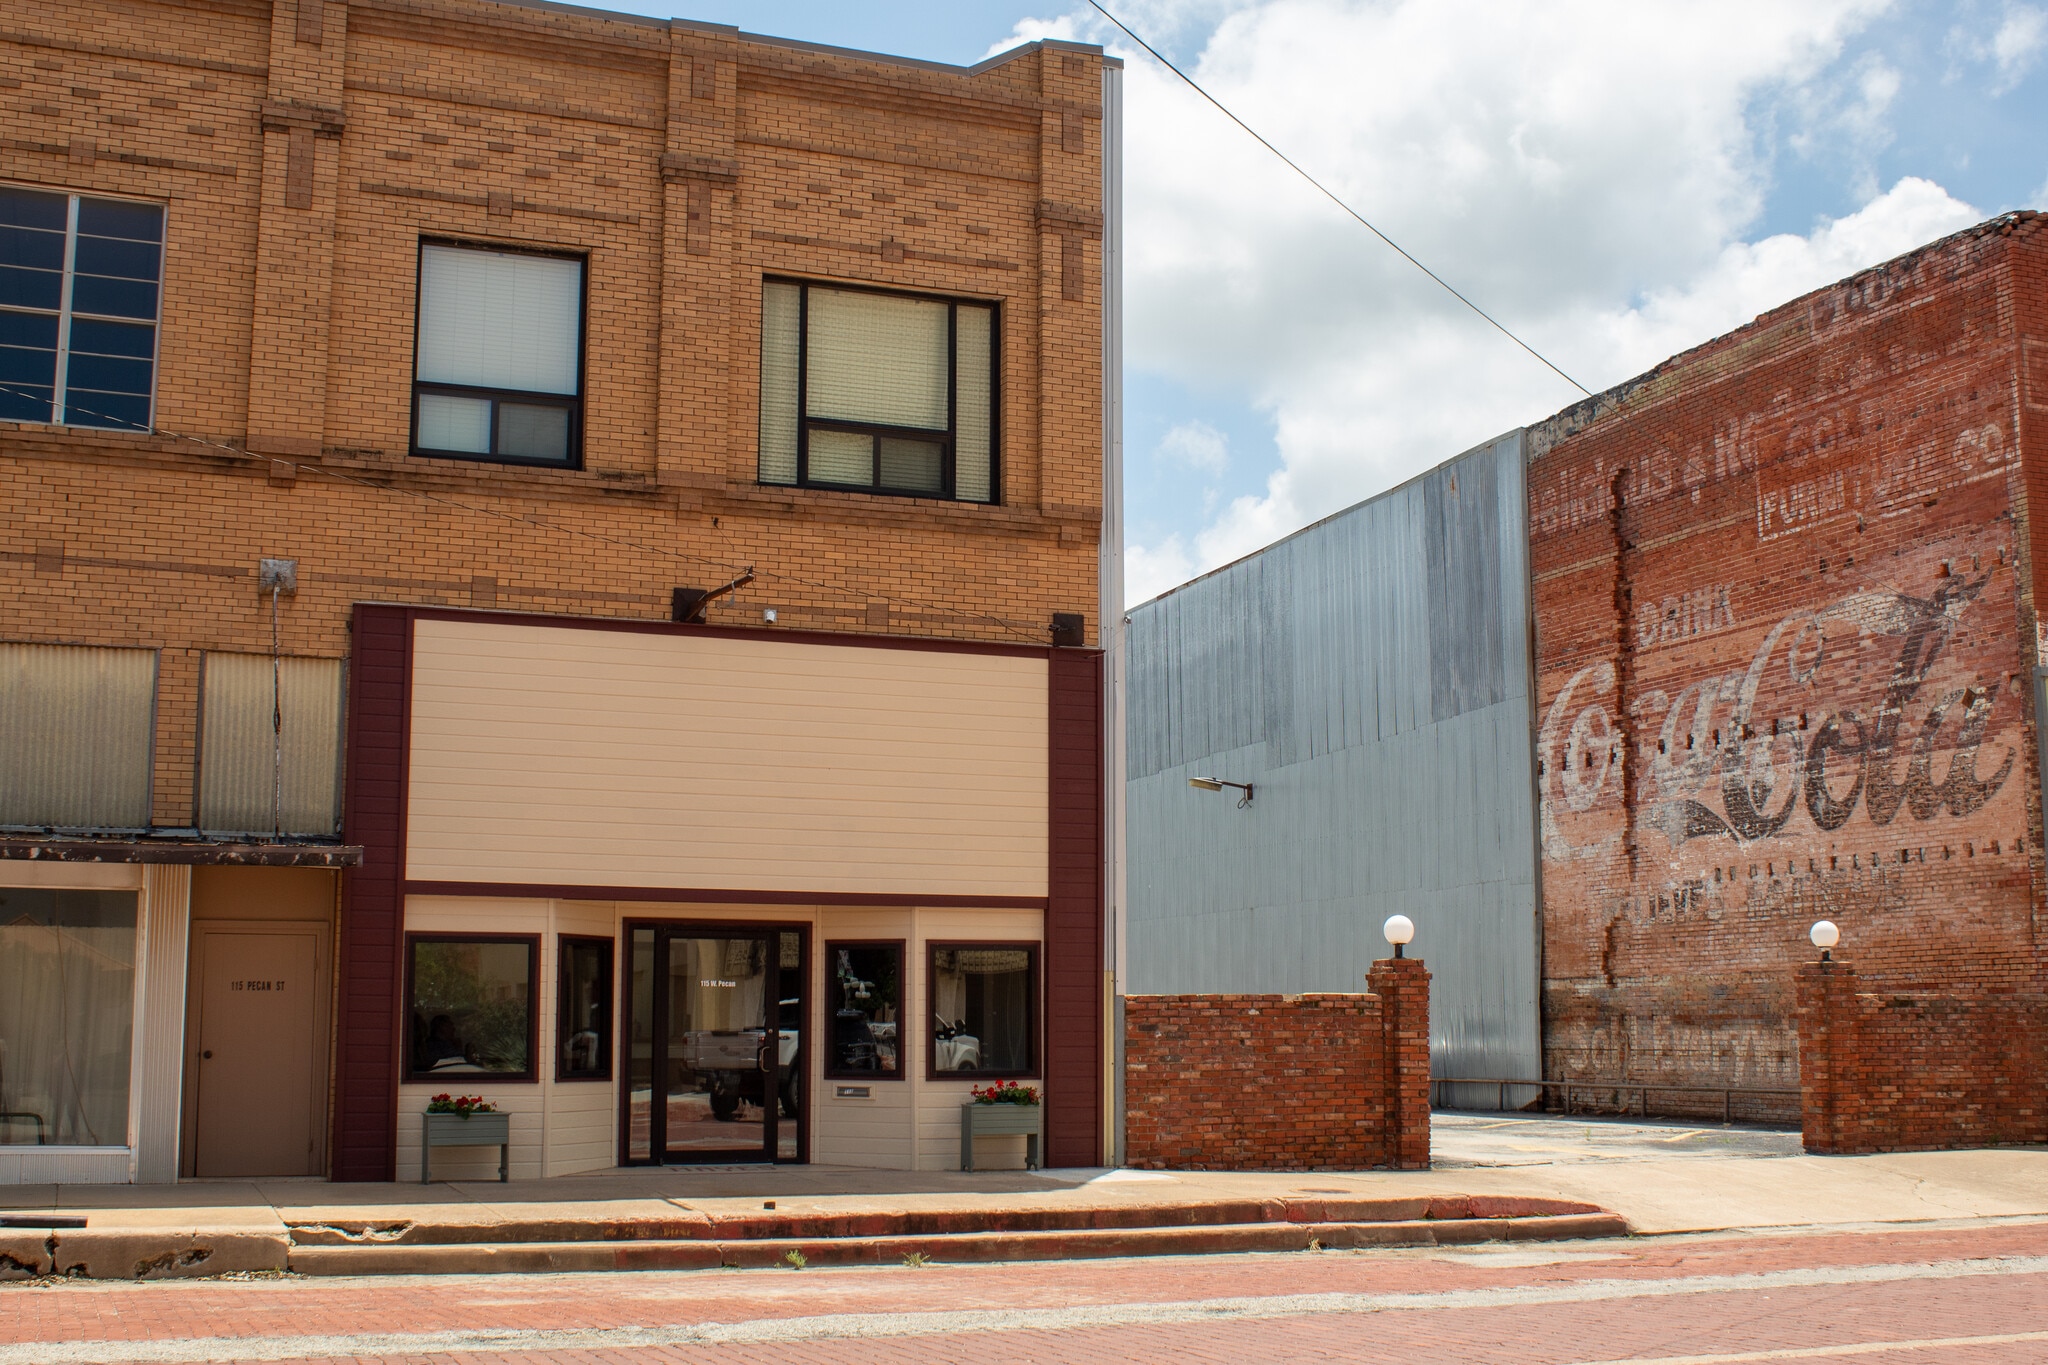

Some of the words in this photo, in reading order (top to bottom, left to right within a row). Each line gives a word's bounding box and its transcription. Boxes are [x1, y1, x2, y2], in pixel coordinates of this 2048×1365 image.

[1637, 580, 1736, 648] DRINK
[231, 981, 244, 991] 115
[247, 981, 272, 991] PECAN
[276, 981, 286, 991] ST
